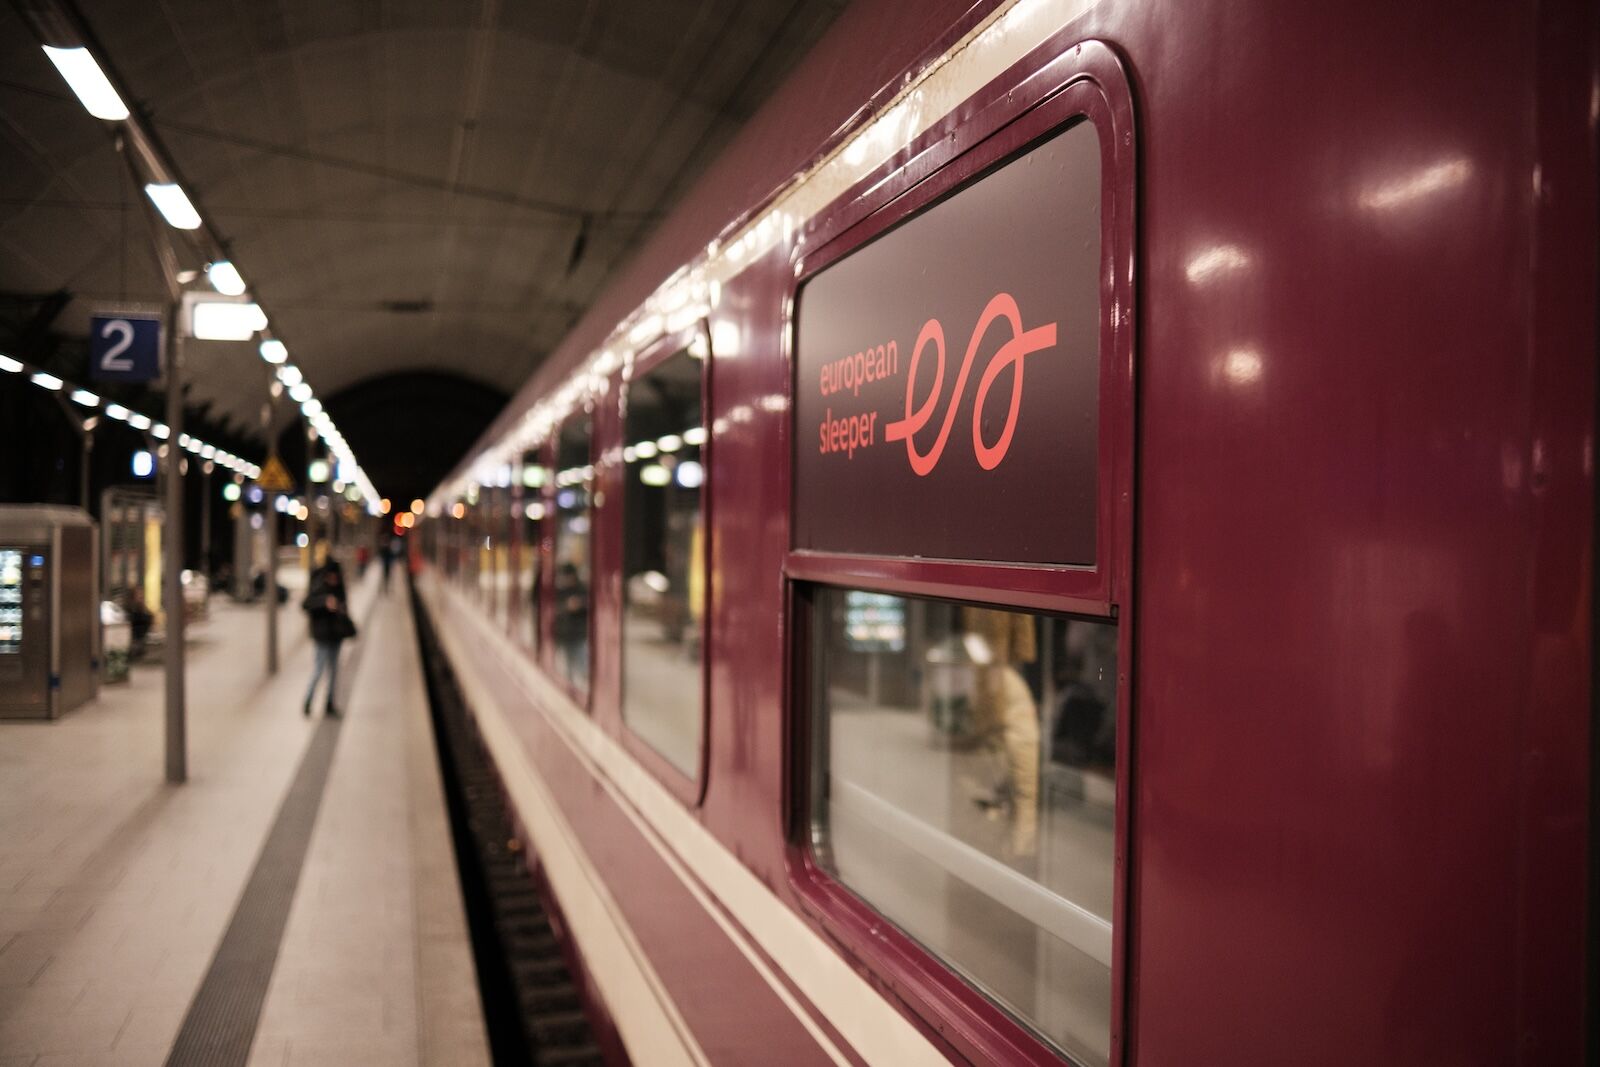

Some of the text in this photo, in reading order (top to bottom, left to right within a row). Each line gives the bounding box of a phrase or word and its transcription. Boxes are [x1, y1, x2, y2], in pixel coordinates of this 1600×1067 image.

[101, 319, 135, 371] 2
[820, 339, 898, 397] european
[819, 408, 878, 459] sleeper
